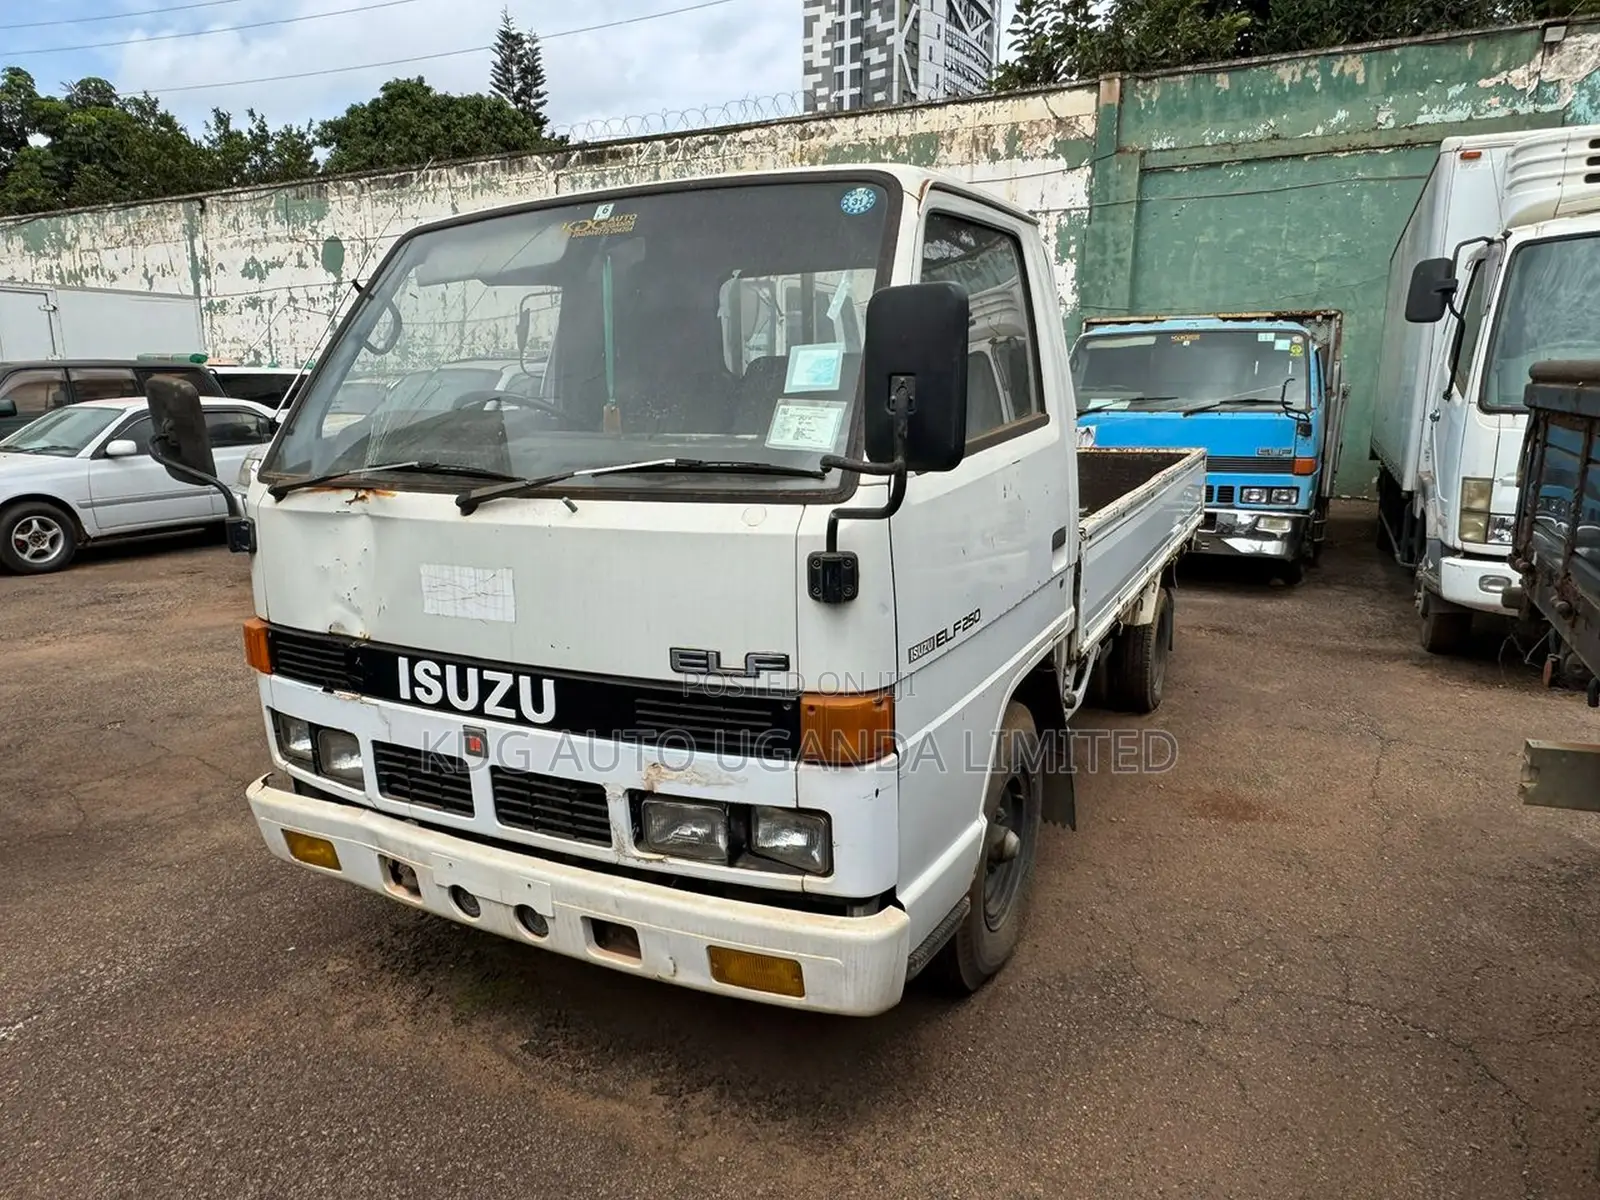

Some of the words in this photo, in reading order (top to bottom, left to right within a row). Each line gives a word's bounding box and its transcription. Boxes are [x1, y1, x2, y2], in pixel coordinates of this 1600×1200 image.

[670, 647, 790, 679] ELF
[909, 637, 935, 662] ISUZU
[398, 656, 556, 724] ISUZU
